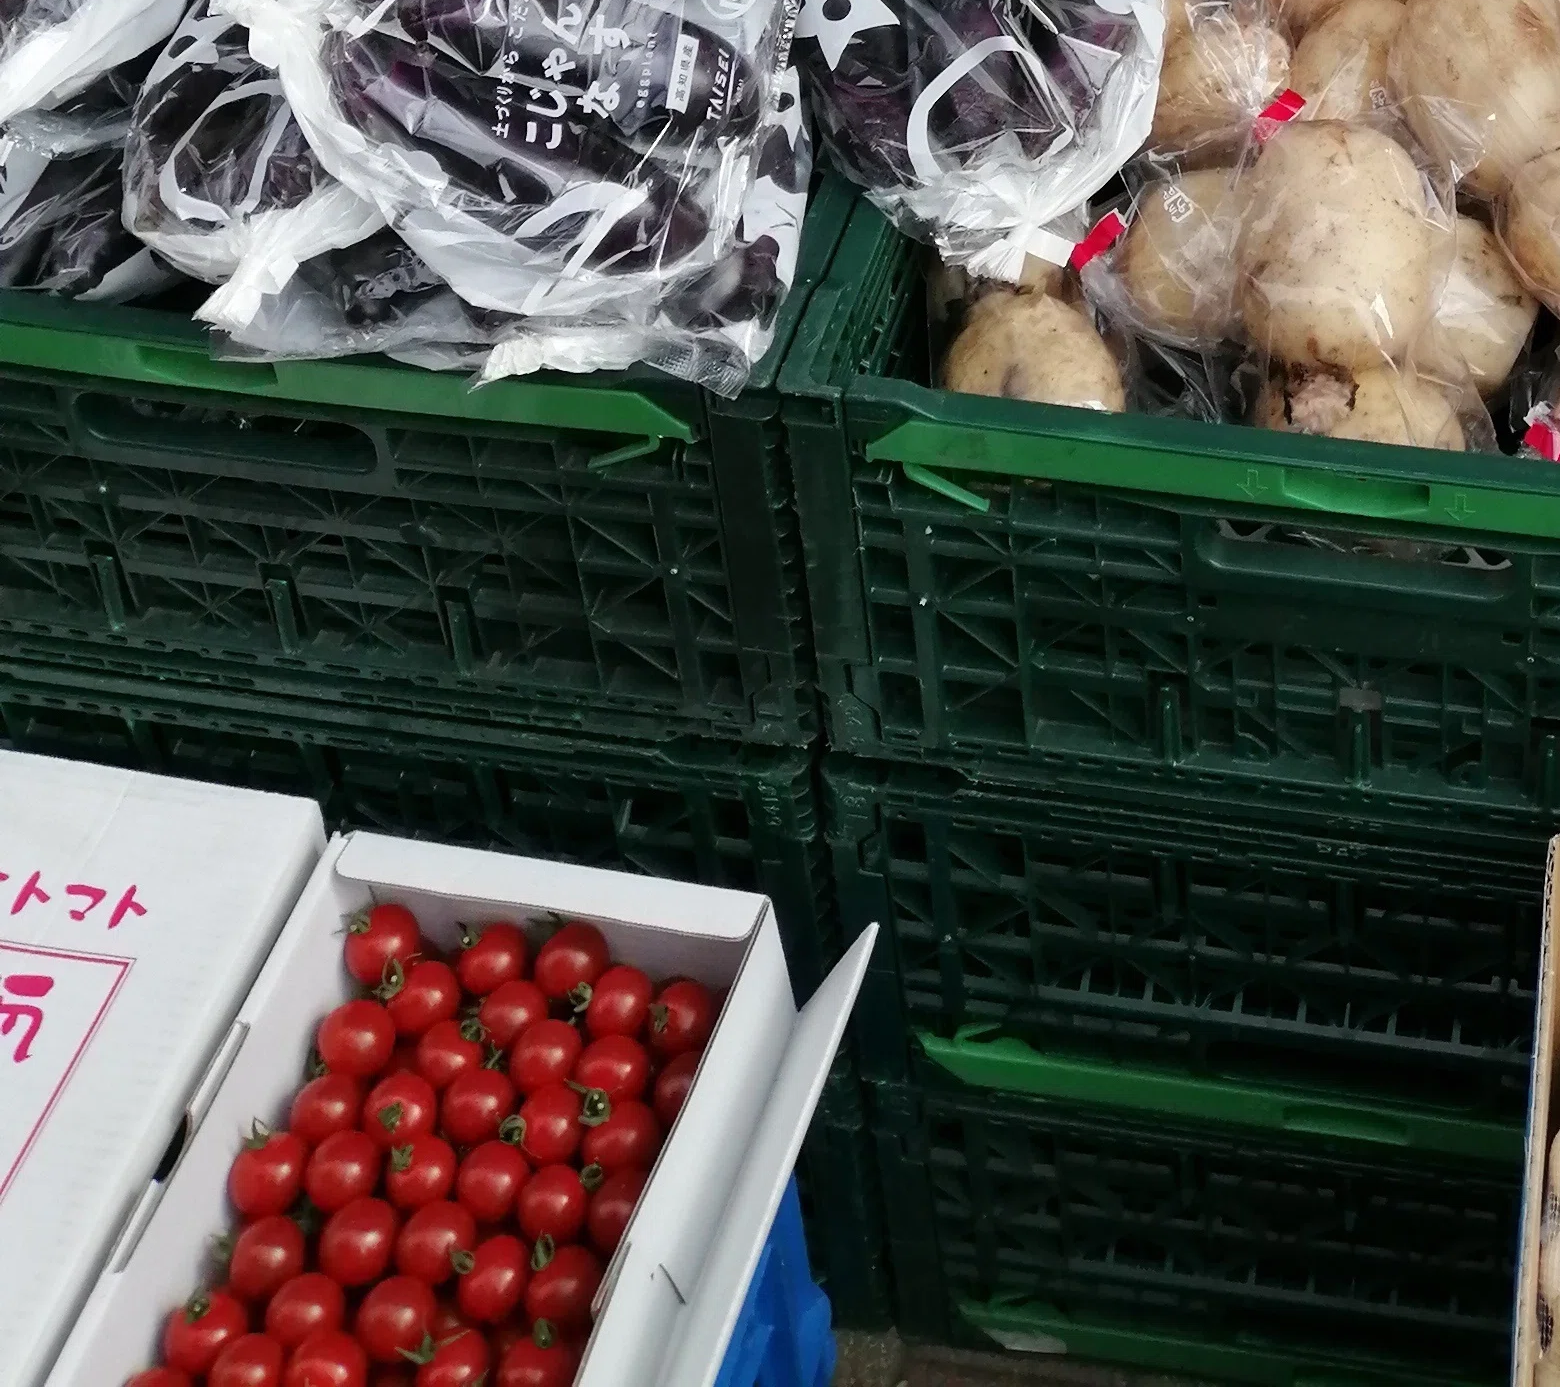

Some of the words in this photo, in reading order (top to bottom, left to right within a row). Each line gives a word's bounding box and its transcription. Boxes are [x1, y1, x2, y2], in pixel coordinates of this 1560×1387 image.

[576, 13, 632, 119] なす
[705, 47, 731, 121] TAISEI
[0, 868, 149, 931] トマト
